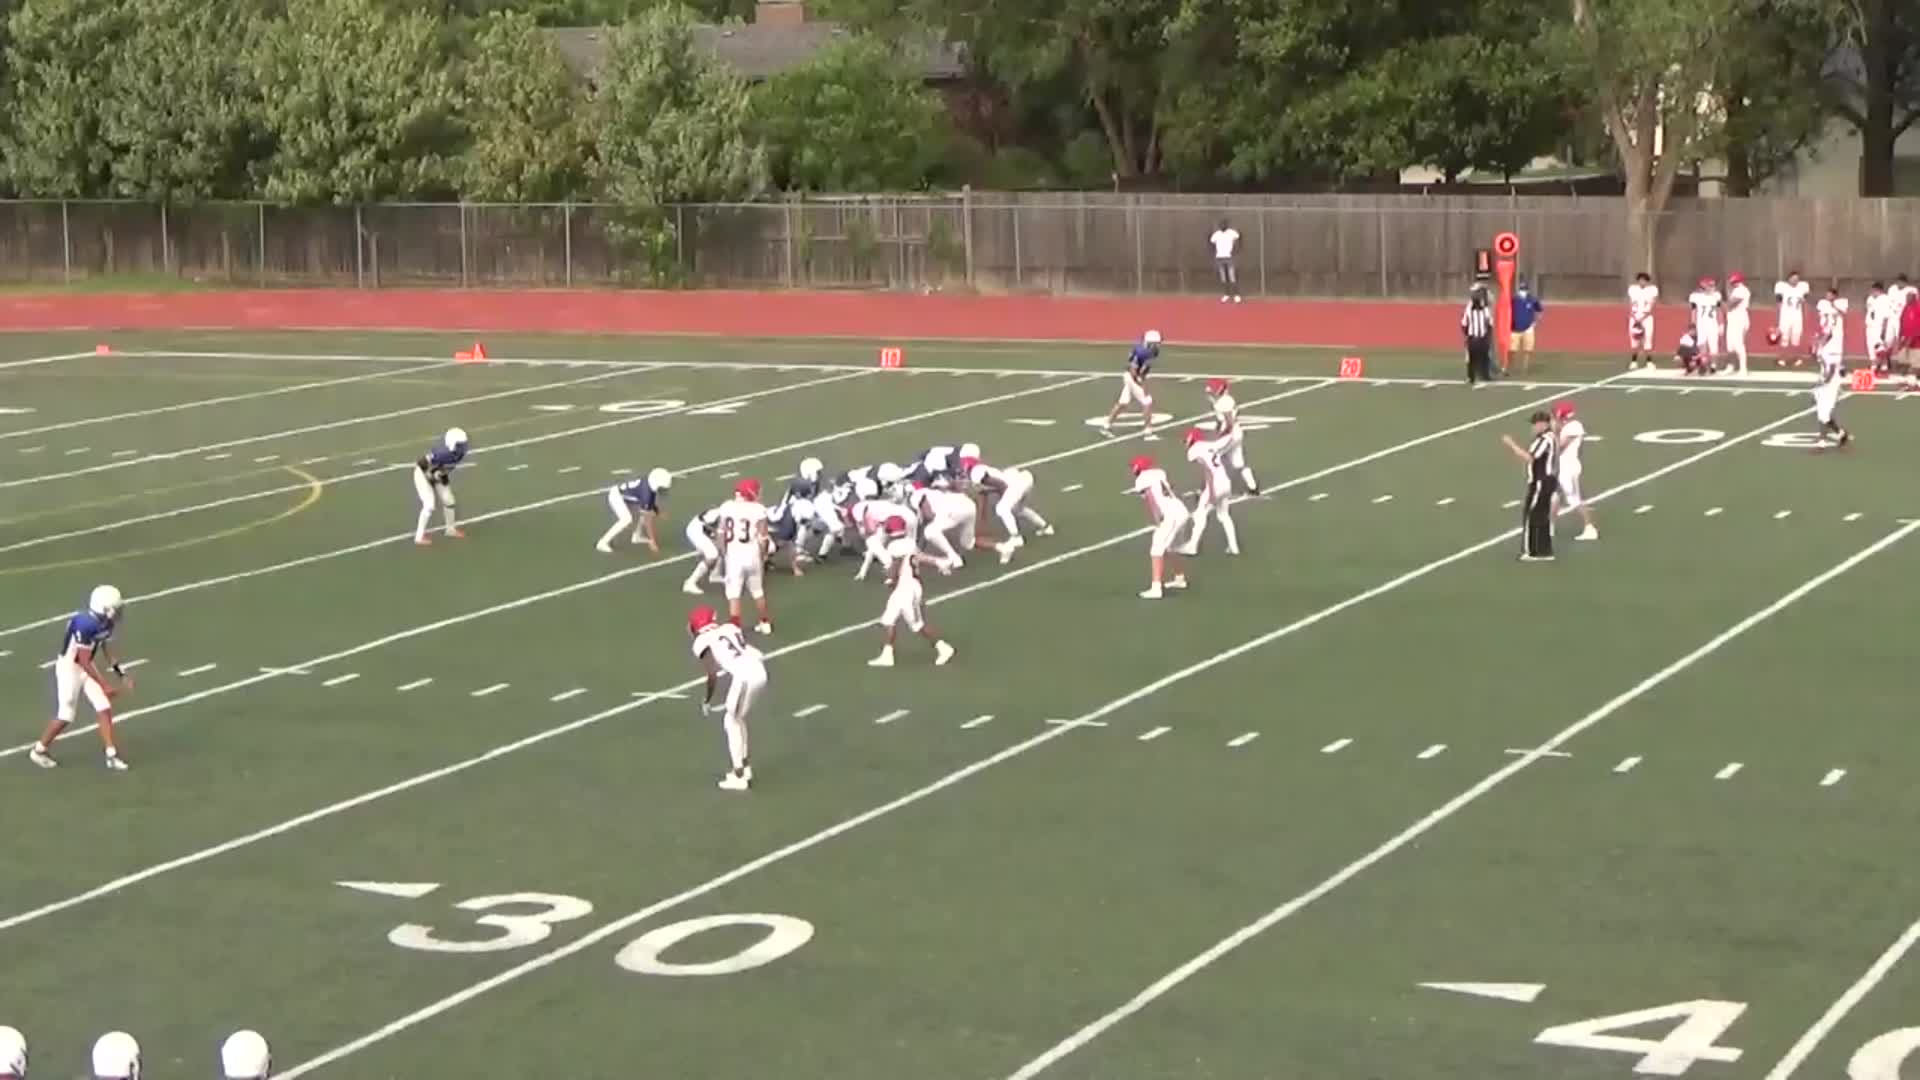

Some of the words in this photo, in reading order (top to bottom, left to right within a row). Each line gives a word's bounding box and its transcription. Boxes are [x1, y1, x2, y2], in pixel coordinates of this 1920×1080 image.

[881, 349, 900, 367] 10
[1340, 358, 1361, 378] 20
[724, 516, 751, 544] 83
[387, 892, 815, 977] 30
